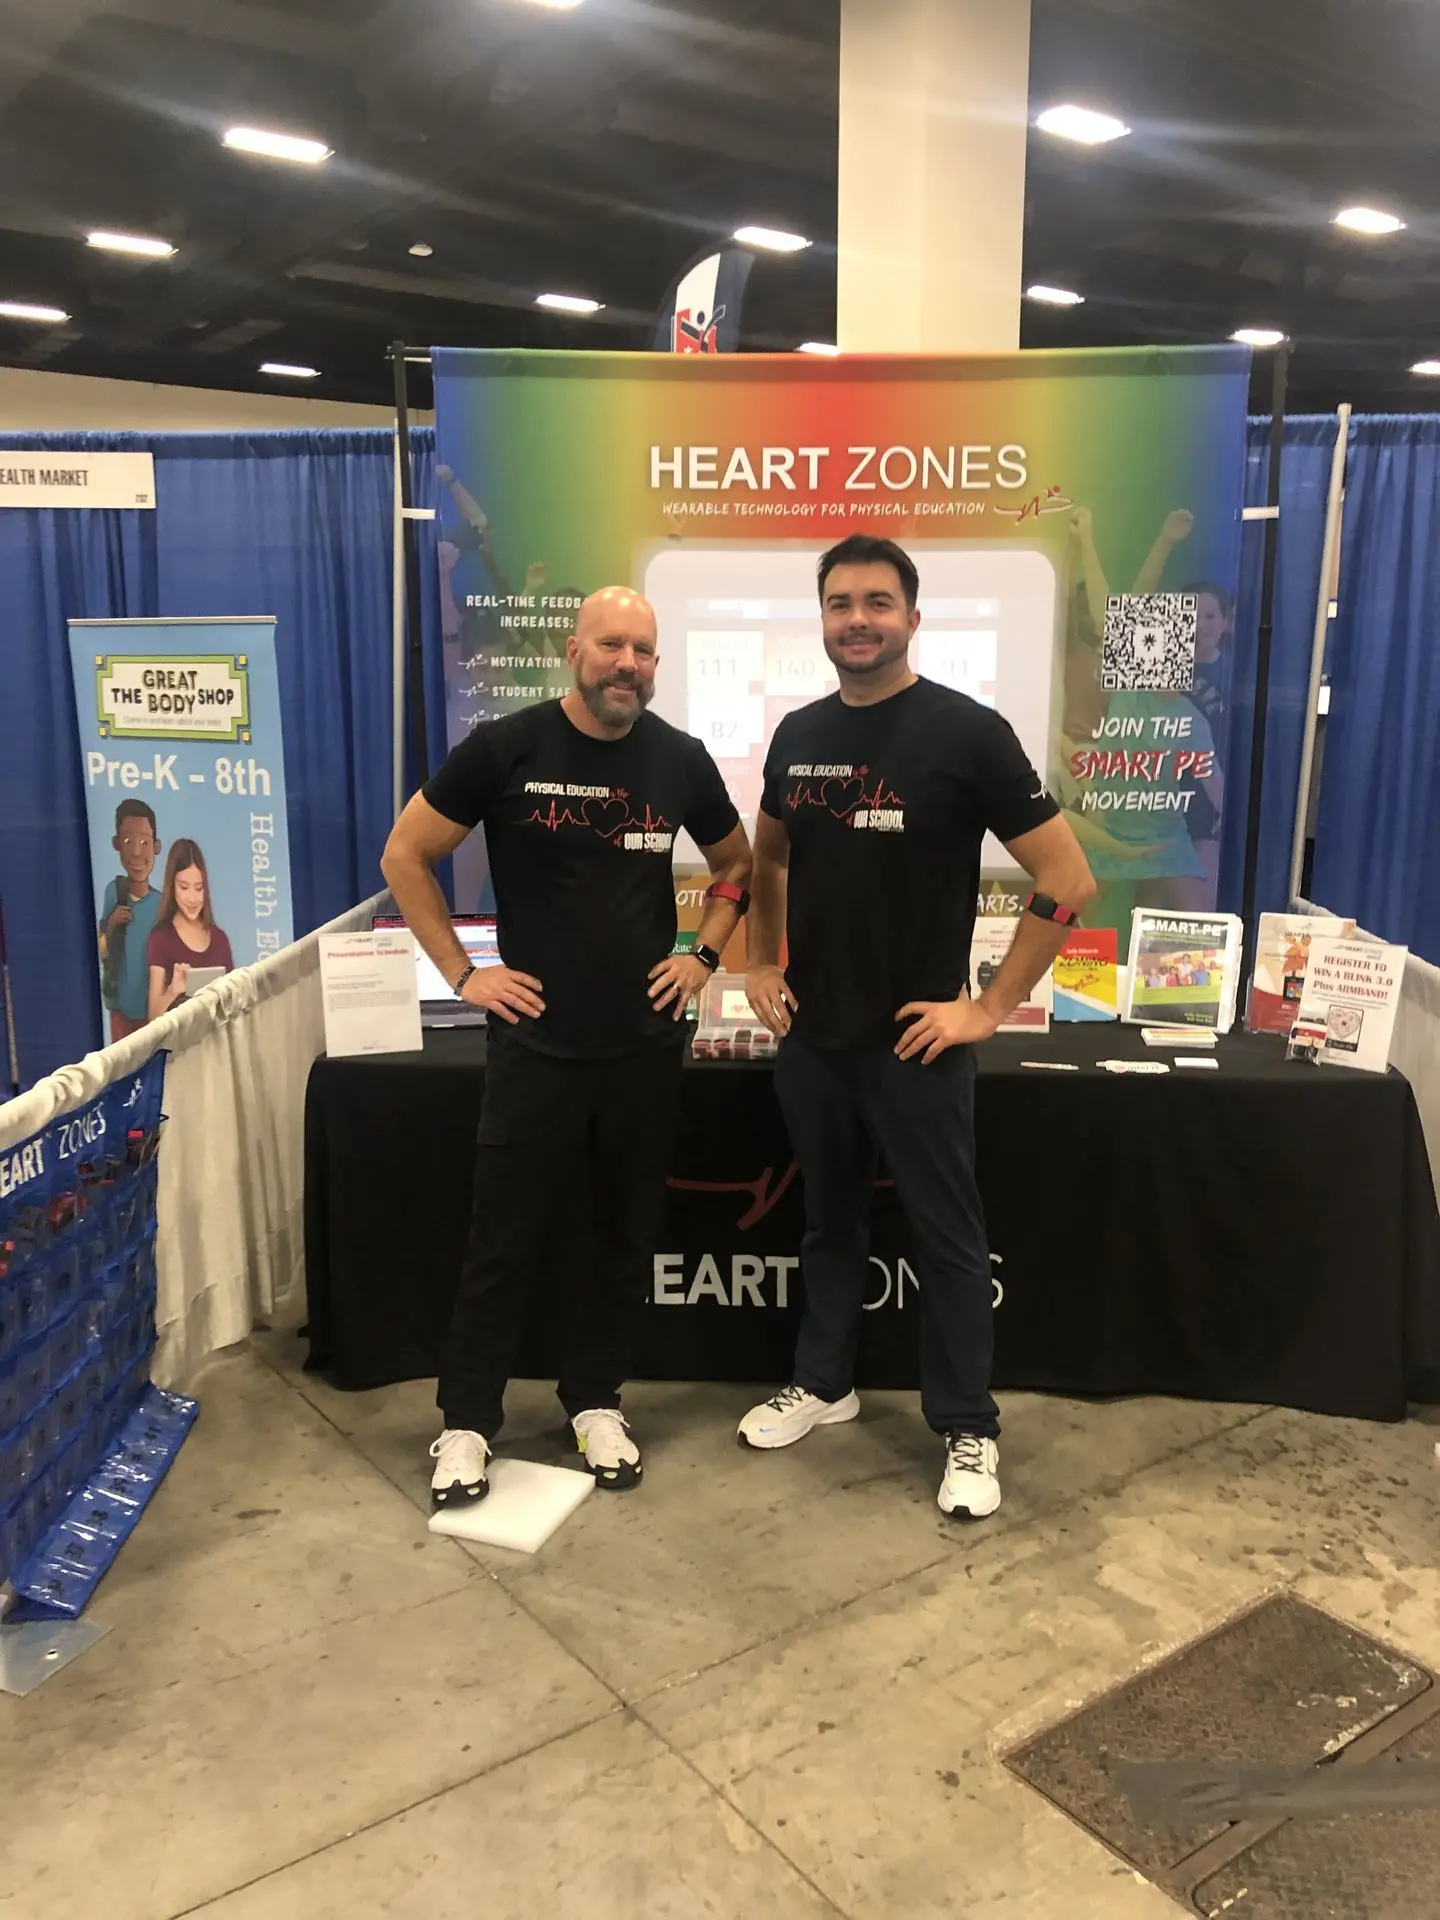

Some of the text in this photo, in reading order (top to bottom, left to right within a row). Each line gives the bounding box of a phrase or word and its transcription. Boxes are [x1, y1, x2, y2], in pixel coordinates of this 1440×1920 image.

[39, 469, 89, 487] MARKET
[650, 444, 1028, 491] HEART ZONES
[662, 501, 986, 517] WEARABLE TECHNOLOGY FOR PHYSICAL EDUCATION
[465, 594, 536, 608] REAL-TIME
[500, 615, 575, 629] INCREASES:
[490, 656, 561, 669] MOTIVATION
[142, 669, 198, 691] GREAT
[110, 687, 235, 715] THE BODY SHOP
[491, 685, 544, 698] STUDENT
[1091, 715, 1193, 740] JOIN THE
[87, 751, 180, 791] Pre-K
[214, 756, 271, 797] 8th
[787, 764, 813, 777] PHYSICAL
[813, 764, 853, 778] EDUCATION
[1070, 749, 1215, 783] SMART PE
[524, 781, 566, 796] PHYSICAL
[566, 783, 610, 799] EDUCATION
[1082, 790, 1196, 814] MOVEMENT
[868, 808, 905, 831] SCHOOL
[624, 832, 643, 851] OUR
[249, 811, 278, 919] Health
[1323, 954, 1371, 970] REGISTER
[1374, 963, 1387, 973] TO
[1314, 967, 1394, 987] WIN A BLINK 3.0
[1313, 979, 1334, 991] Plus
[1336, 984, 1389, 1000] ARMBAND!
[57, 1100, 108, 1161] ZONES
[645, 1253, 799, 1307] EART
